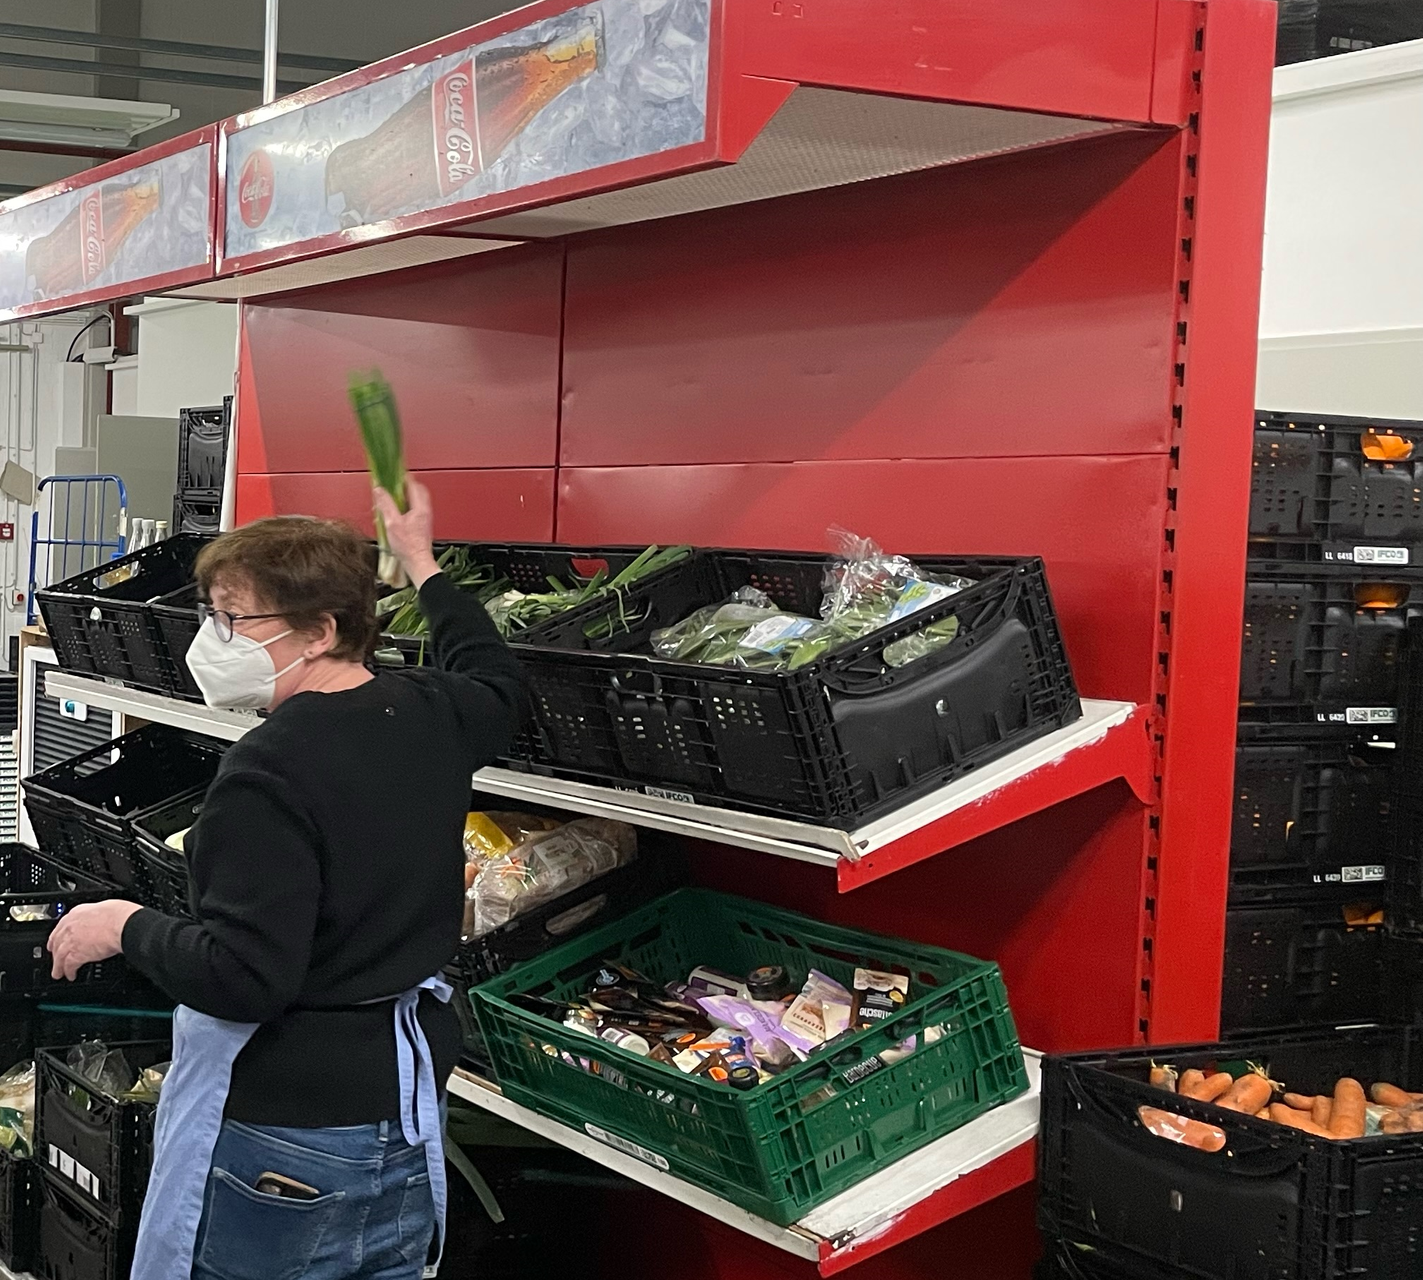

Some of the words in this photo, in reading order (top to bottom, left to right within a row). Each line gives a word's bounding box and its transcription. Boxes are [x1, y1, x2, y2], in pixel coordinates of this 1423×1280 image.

[443, 72, 475, 183] Coca-Cola
[84, 196, 102, 275] Coca-Cola
[1370, 710, 1389, 718] IFCO
